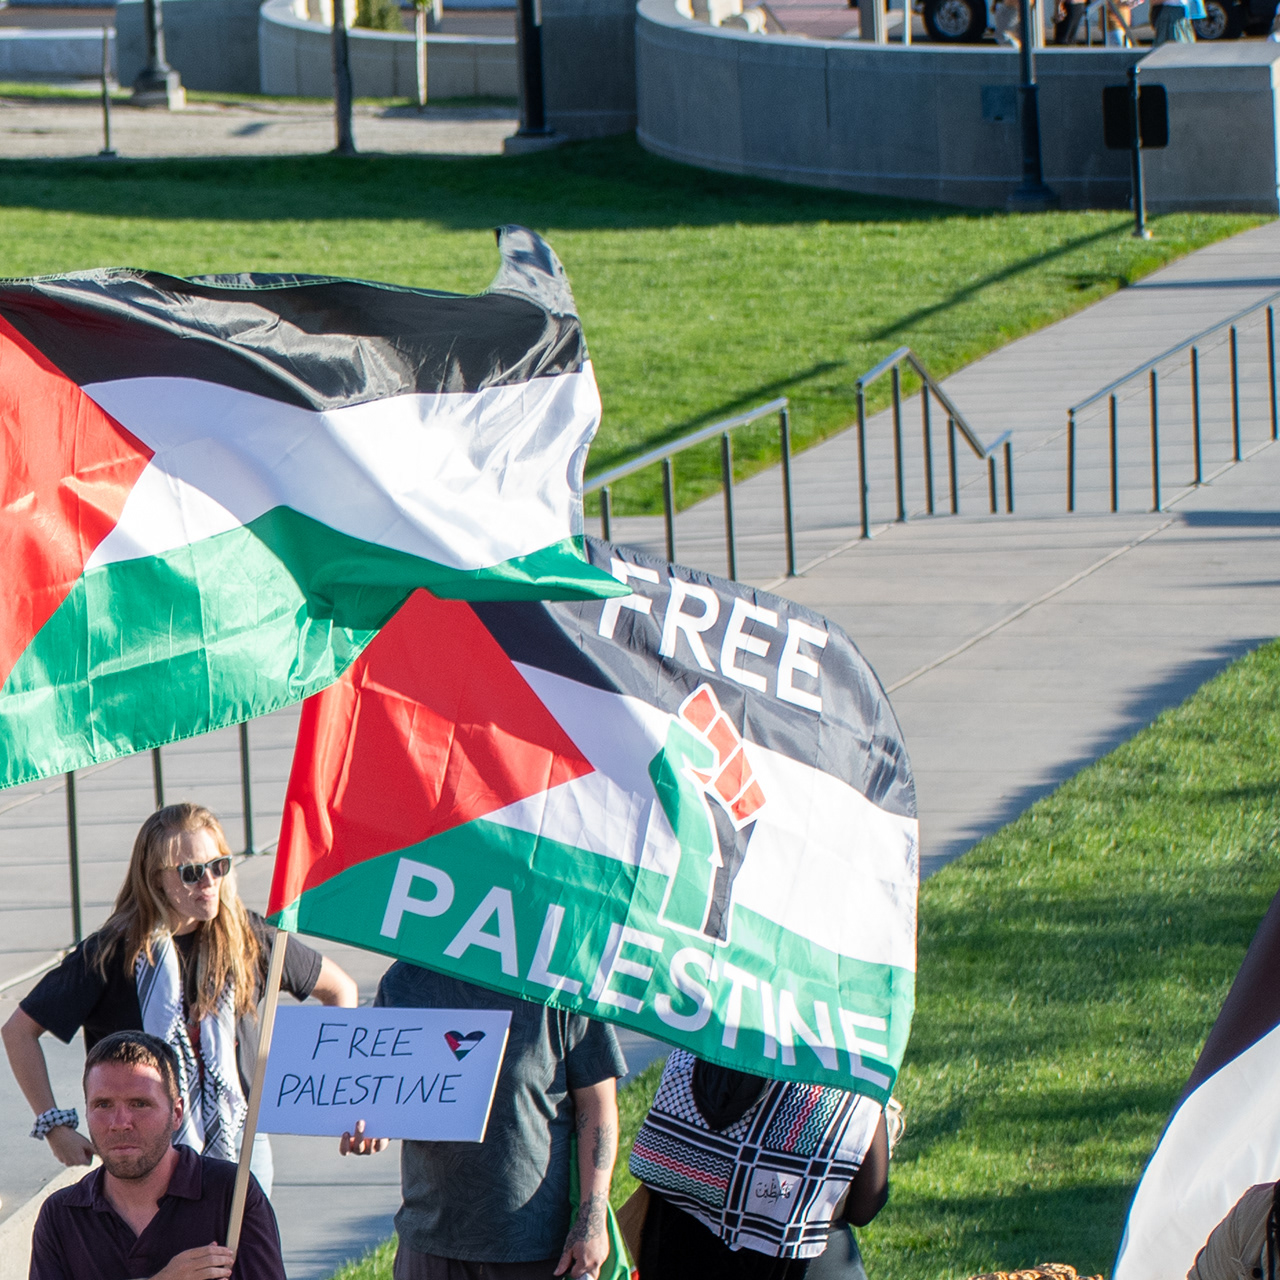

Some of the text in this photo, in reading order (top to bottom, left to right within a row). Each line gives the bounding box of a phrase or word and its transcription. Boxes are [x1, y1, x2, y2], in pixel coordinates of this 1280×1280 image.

[598, 557, 828, 713] FREE
[379, 857, 891, 1090] PALESTINE
[276, 1072, 462, 1107] PALESTINE
[311, 1022, 423, 1060] FREE
